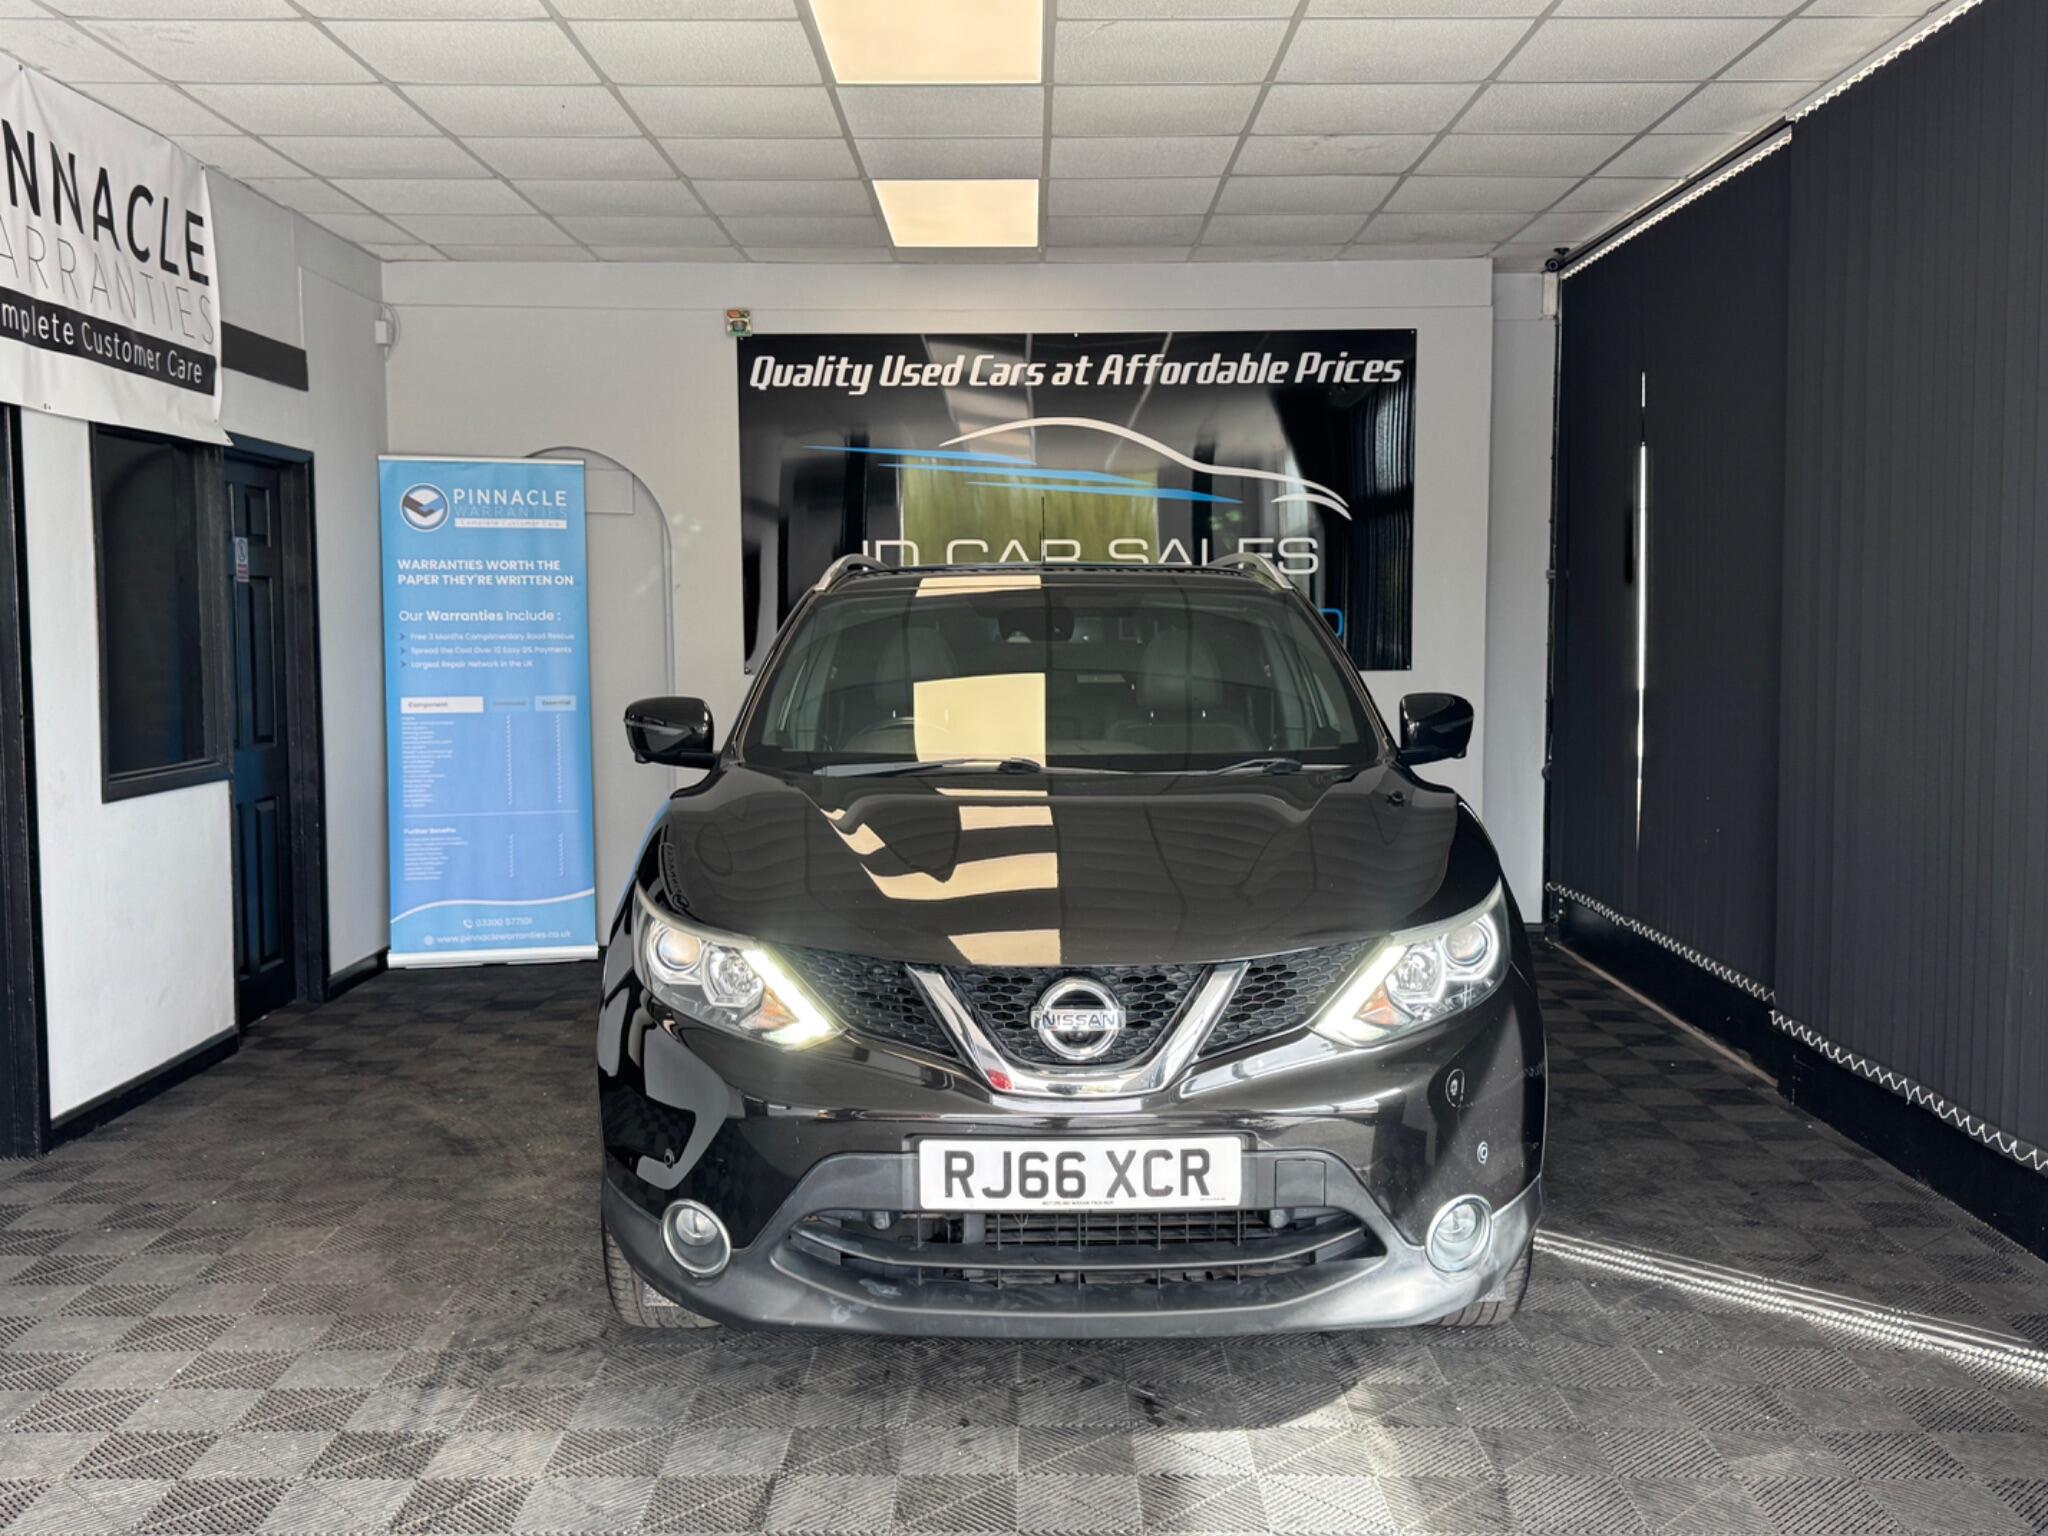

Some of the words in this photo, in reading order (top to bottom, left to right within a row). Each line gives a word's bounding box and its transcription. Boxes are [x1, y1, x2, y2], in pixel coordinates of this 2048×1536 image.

[1, 118, 210, 286] NNACLE
[1, 301, 75, 346] mplete
[81, 321, 160, 373] Customer
[167, 350, 203, 384] Care
[750, 355, 873, 395] Quality
[879, 355, 966, 387] Used
[968, 354, 1047, 386] Cars
[1051, 354, 1093, 386] at
[1096, 352, 1289, 385] Affordable
[1294, 351, 1404, 383] Prices
[453, 488, 567, 506] PINNACLE
[454, 505, 567, 518] WARRANTIES
[397, 559, 483, 570] WARRANTIES
[486, 560, 534, 570] WORTH
[536, 560, 560, 570] THE
[397, 574, 439, 585] PAPER
[442, 574, 493, 585] THEY'RE
[495, 575, 552, 585] WRITTEN
[554, 575, 574, 585] ON
[399, 610, 423, 621] Our
[426, 609, 503, 621] Warranties
[506, 610, 555, 621] Include
[1042, 1012, 1116, 1027] NISSAN
[944, 1150, 1087, 1199] RJ66
[1106, 1149, 1211, 1197] XCR
